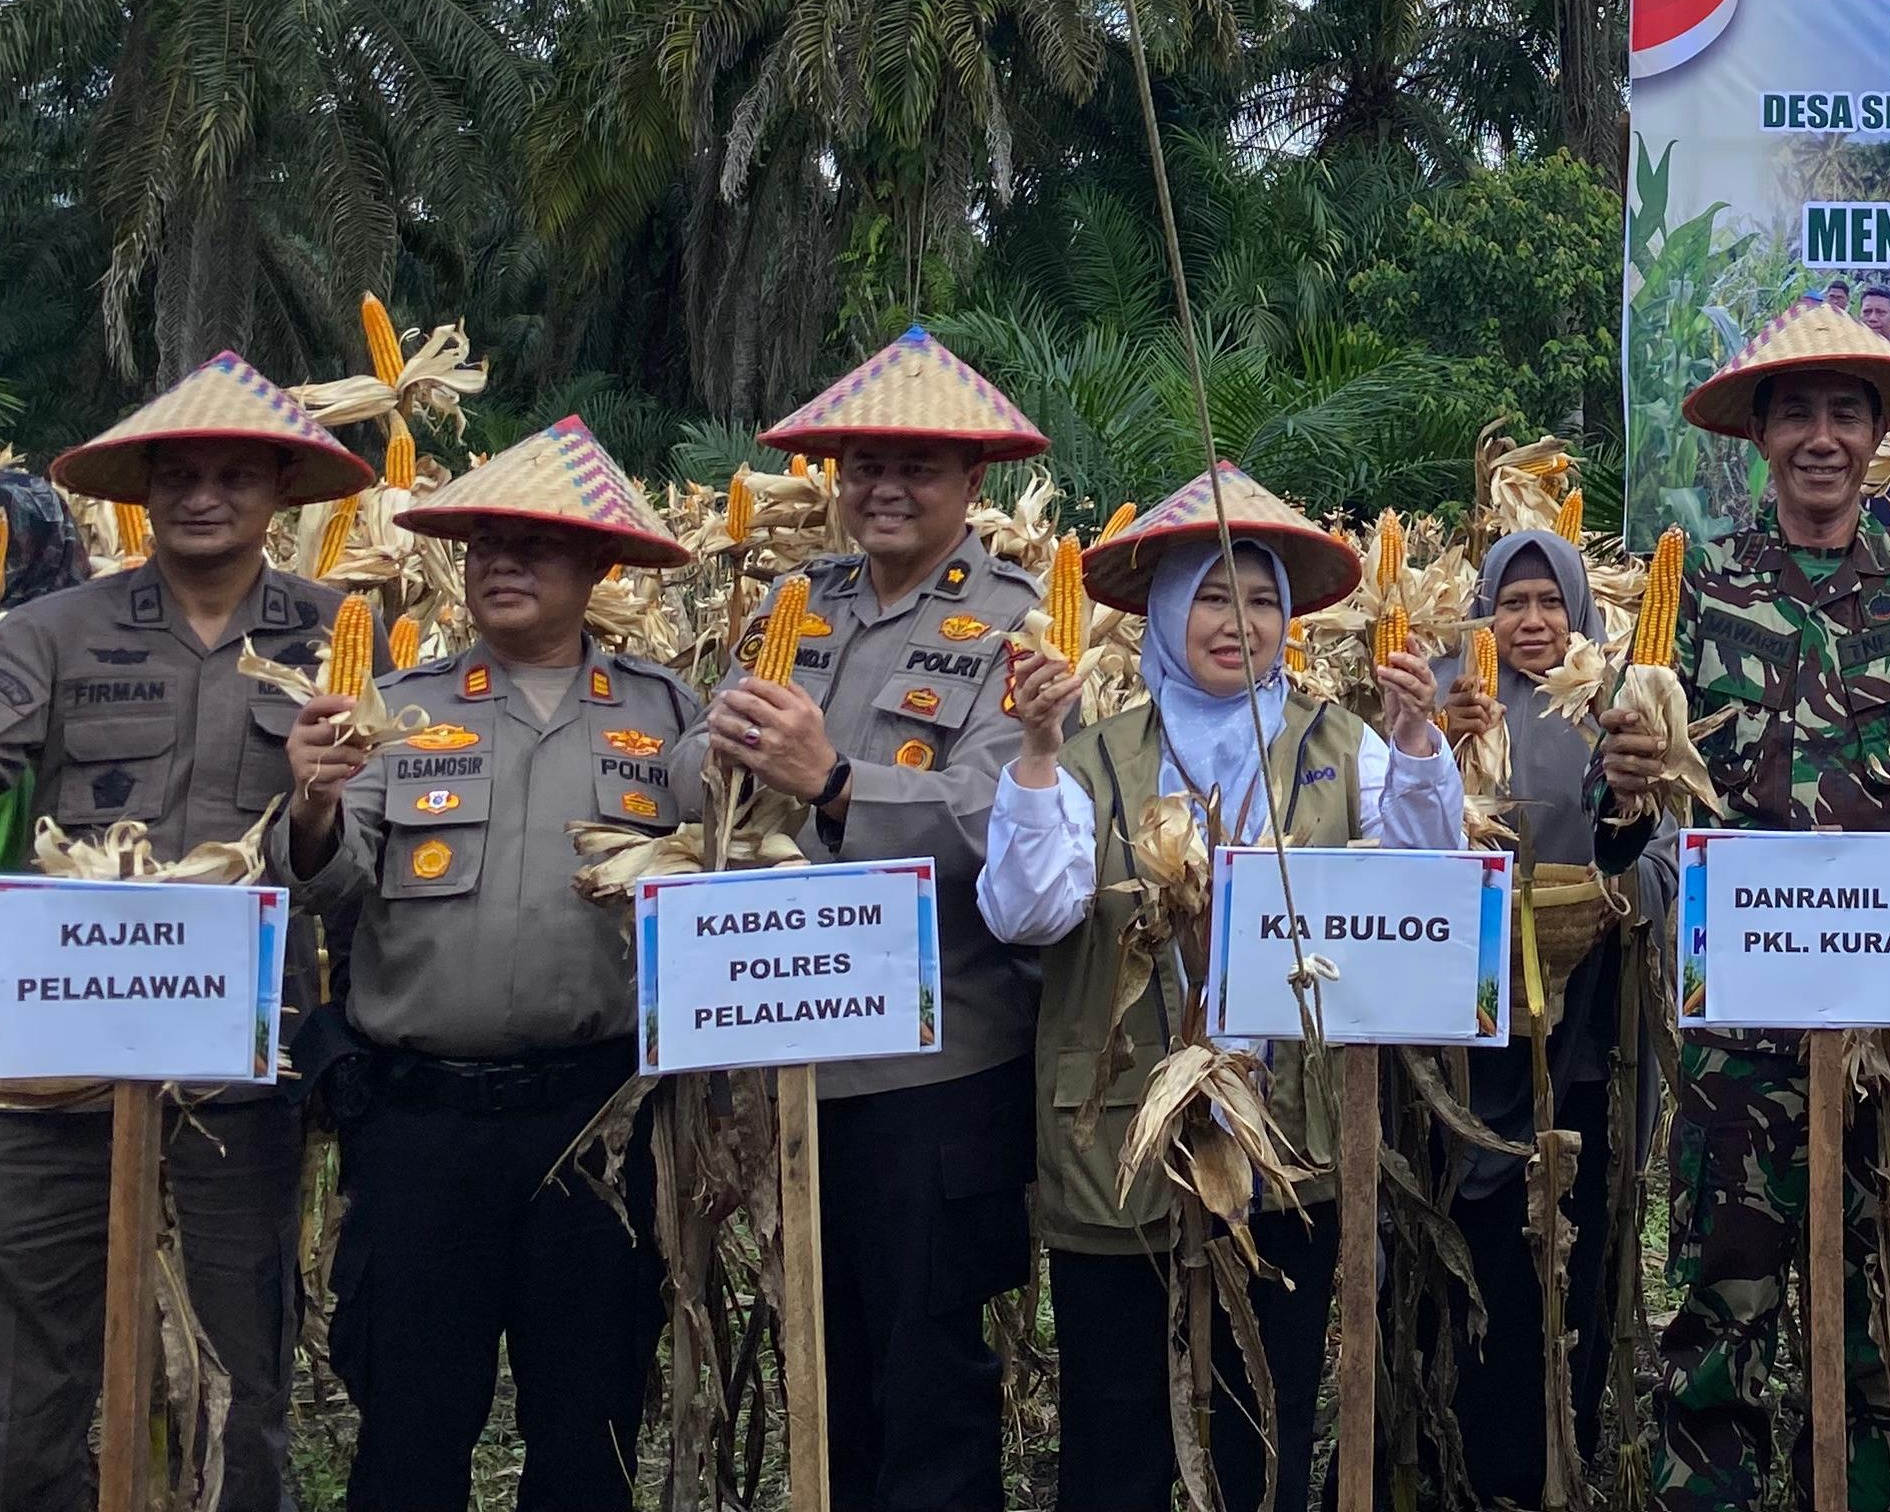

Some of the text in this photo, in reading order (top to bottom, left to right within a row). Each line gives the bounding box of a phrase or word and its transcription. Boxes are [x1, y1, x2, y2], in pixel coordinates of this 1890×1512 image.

[1763, 94, 1853, 129] DESA
[906, 649, 984, 678] POLRI
[74, 680, 166, 706] FIRMAN
[600, 758, 669, 789] POLRI
[1734, 887, 1889, 909] DANRAMIL
[60, 921, 186, 947] KAJARI
[696, 903, 883, 938] KABAG SDM
[1260, 914, 1451, 942] KA BULOG
[1743, 931, 1810, 954] PKL.
[729, 952, 852, 982] POLRES
[17, 974, 227, 1002] PELALAWAN
[694, 994, 886, 1030] PELALAWAN
